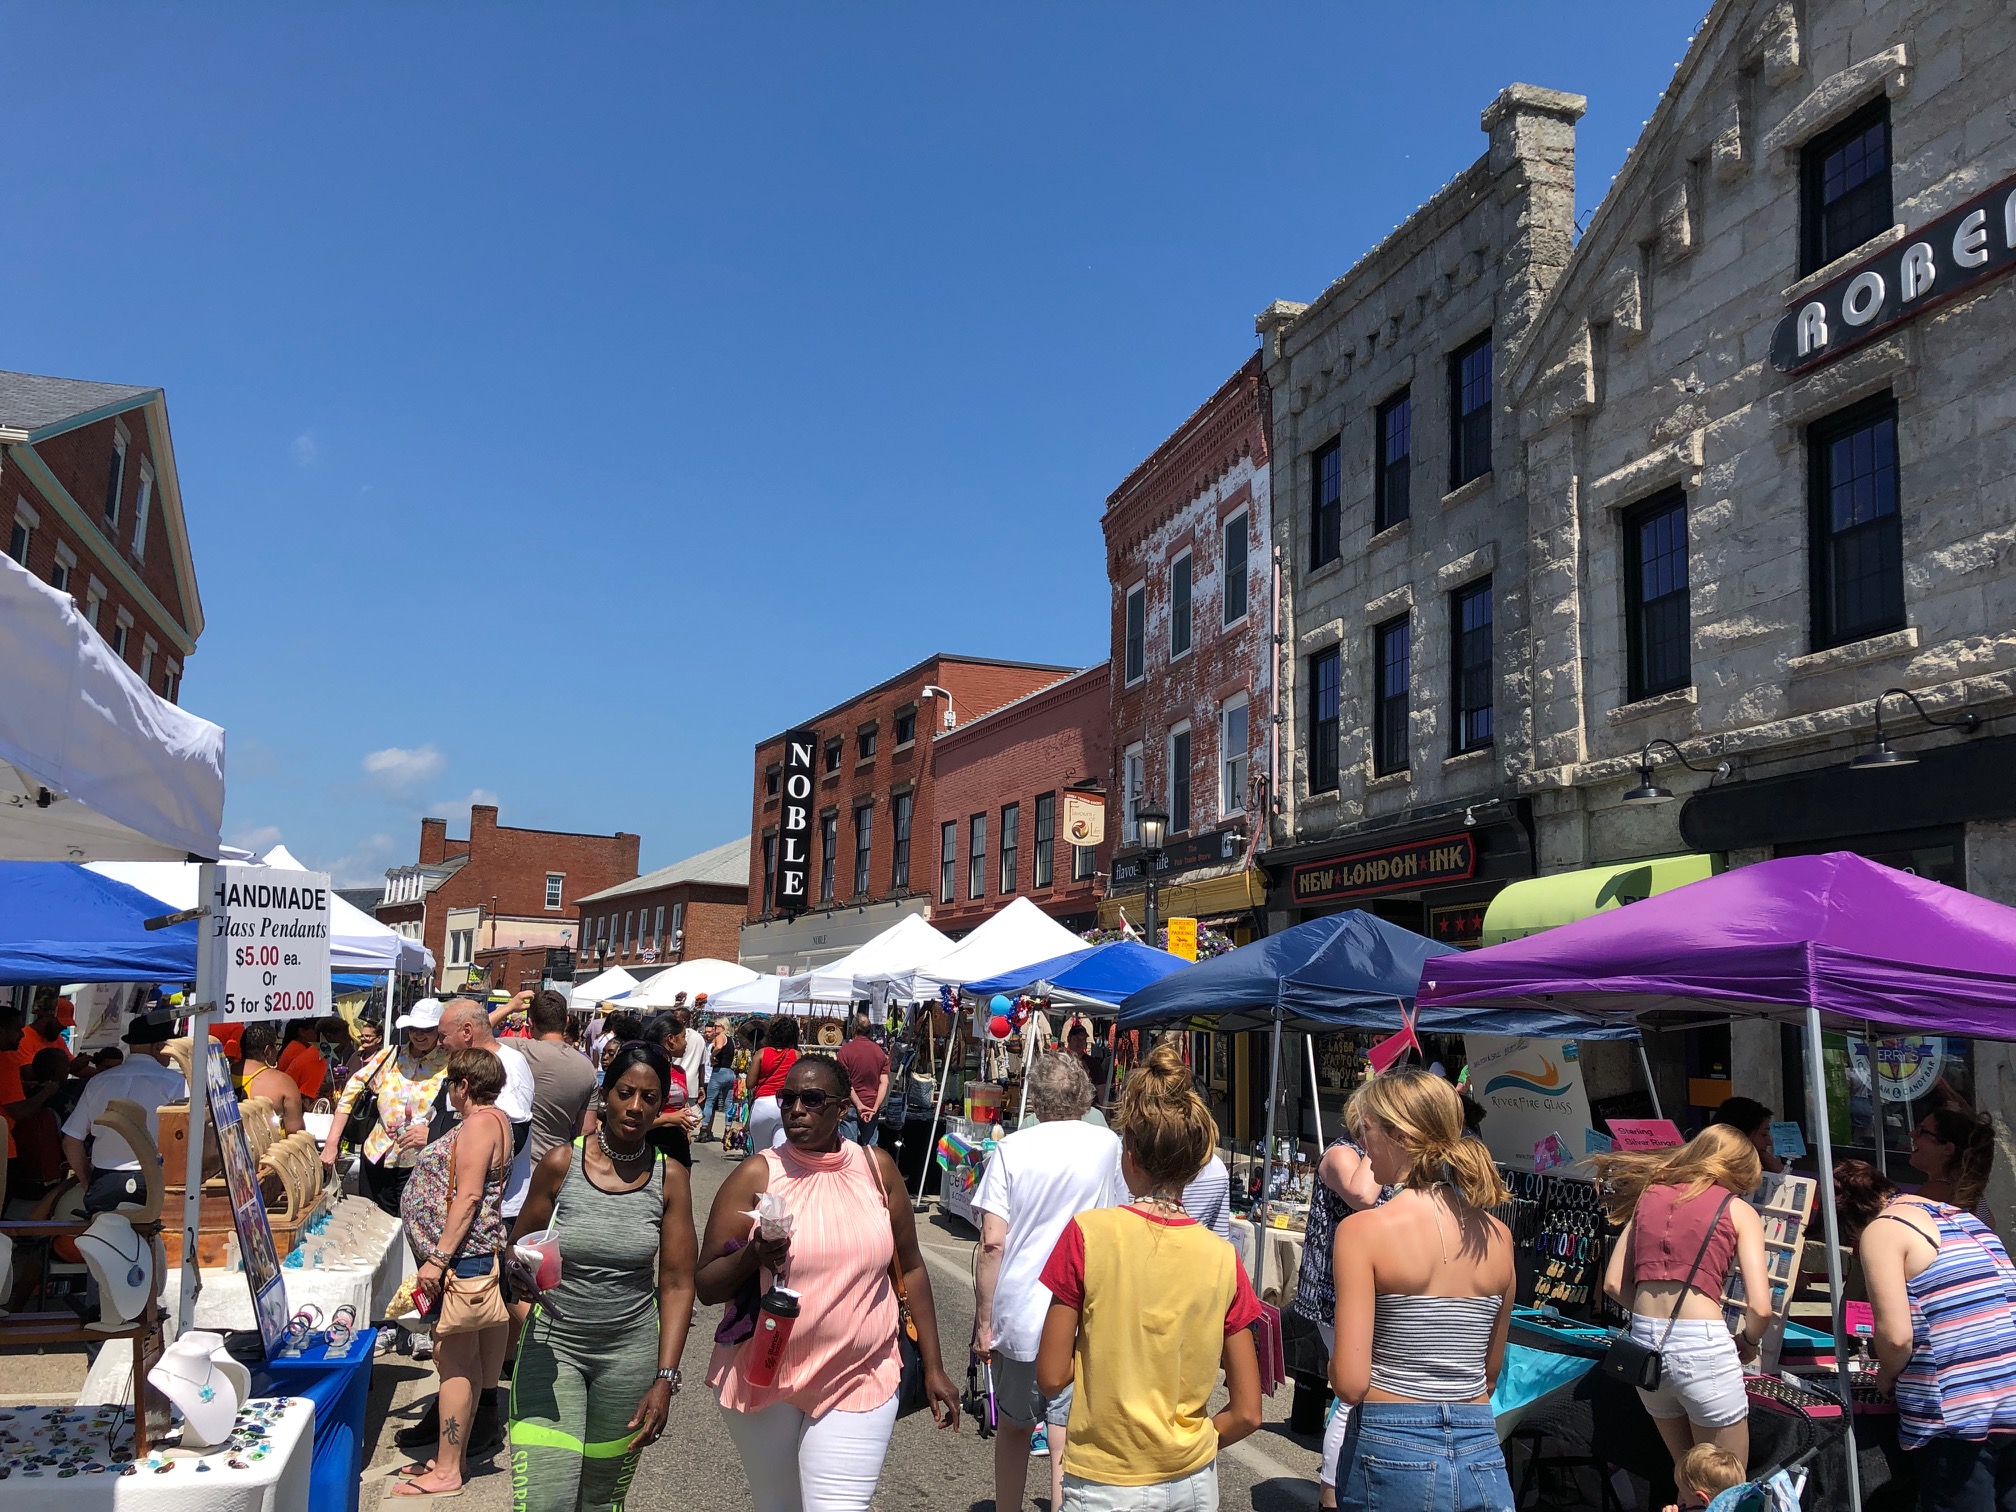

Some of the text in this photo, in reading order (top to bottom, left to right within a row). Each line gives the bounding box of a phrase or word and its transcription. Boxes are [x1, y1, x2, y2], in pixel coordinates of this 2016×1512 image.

[782, 742, 814, 896] NOBLE
[1299, 845, 1466, 894] NEW LONDON INK
[215, 882, 326, 910] HANDMADE
[212, 915, 327, 939] Glass Pendants
[235, 945, 301, 968] $5.00 ea.
[262, 970, 277, 986] Or
[224, 990, 314, 1014] 5 for $20.00
[1877, 1049, 1919, 1062] ERRY'S
[1617, 1127, 1653, 1136] Sterling
[511, 1450, 529, 1512] SPORT
